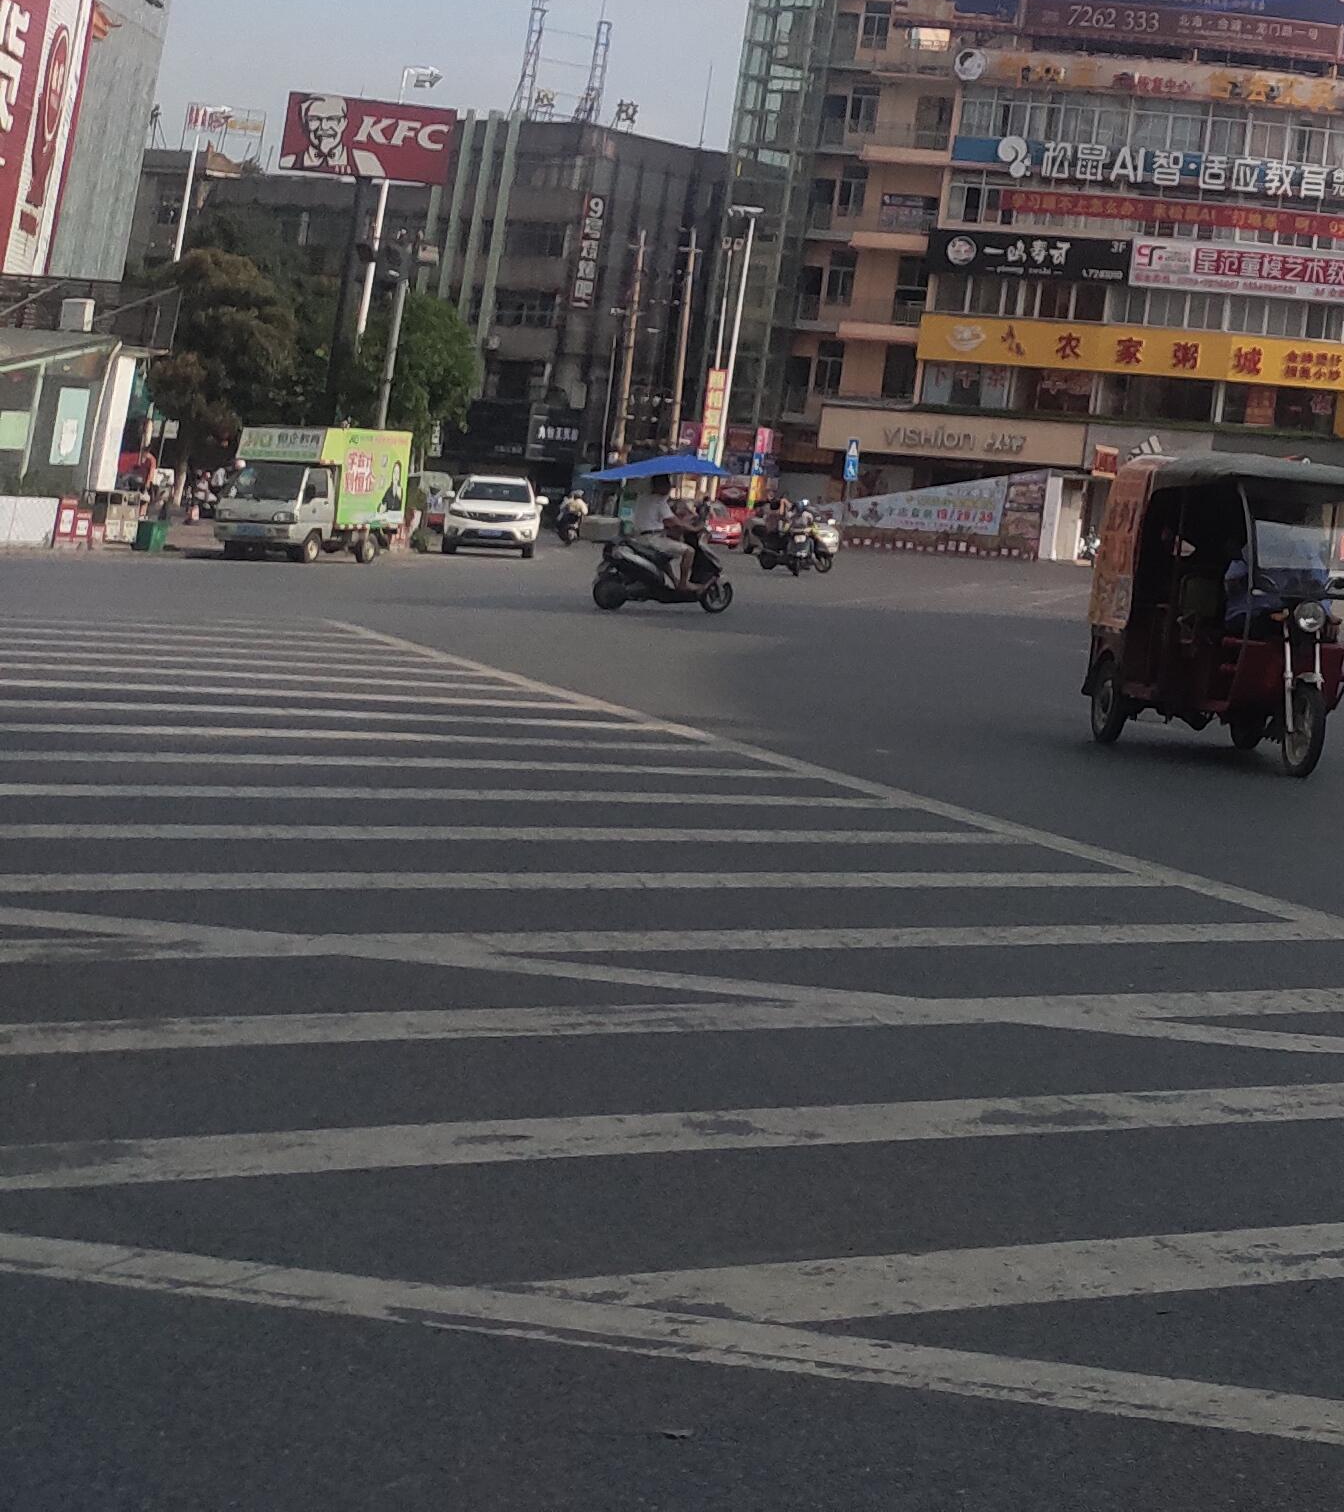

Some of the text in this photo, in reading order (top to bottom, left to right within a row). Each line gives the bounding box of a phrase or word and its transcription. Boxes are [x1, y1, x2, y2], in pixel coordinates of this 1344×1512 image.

[1067, 4, 1160, 33] 7262 333
[353, 115, 450, 150] KFC
